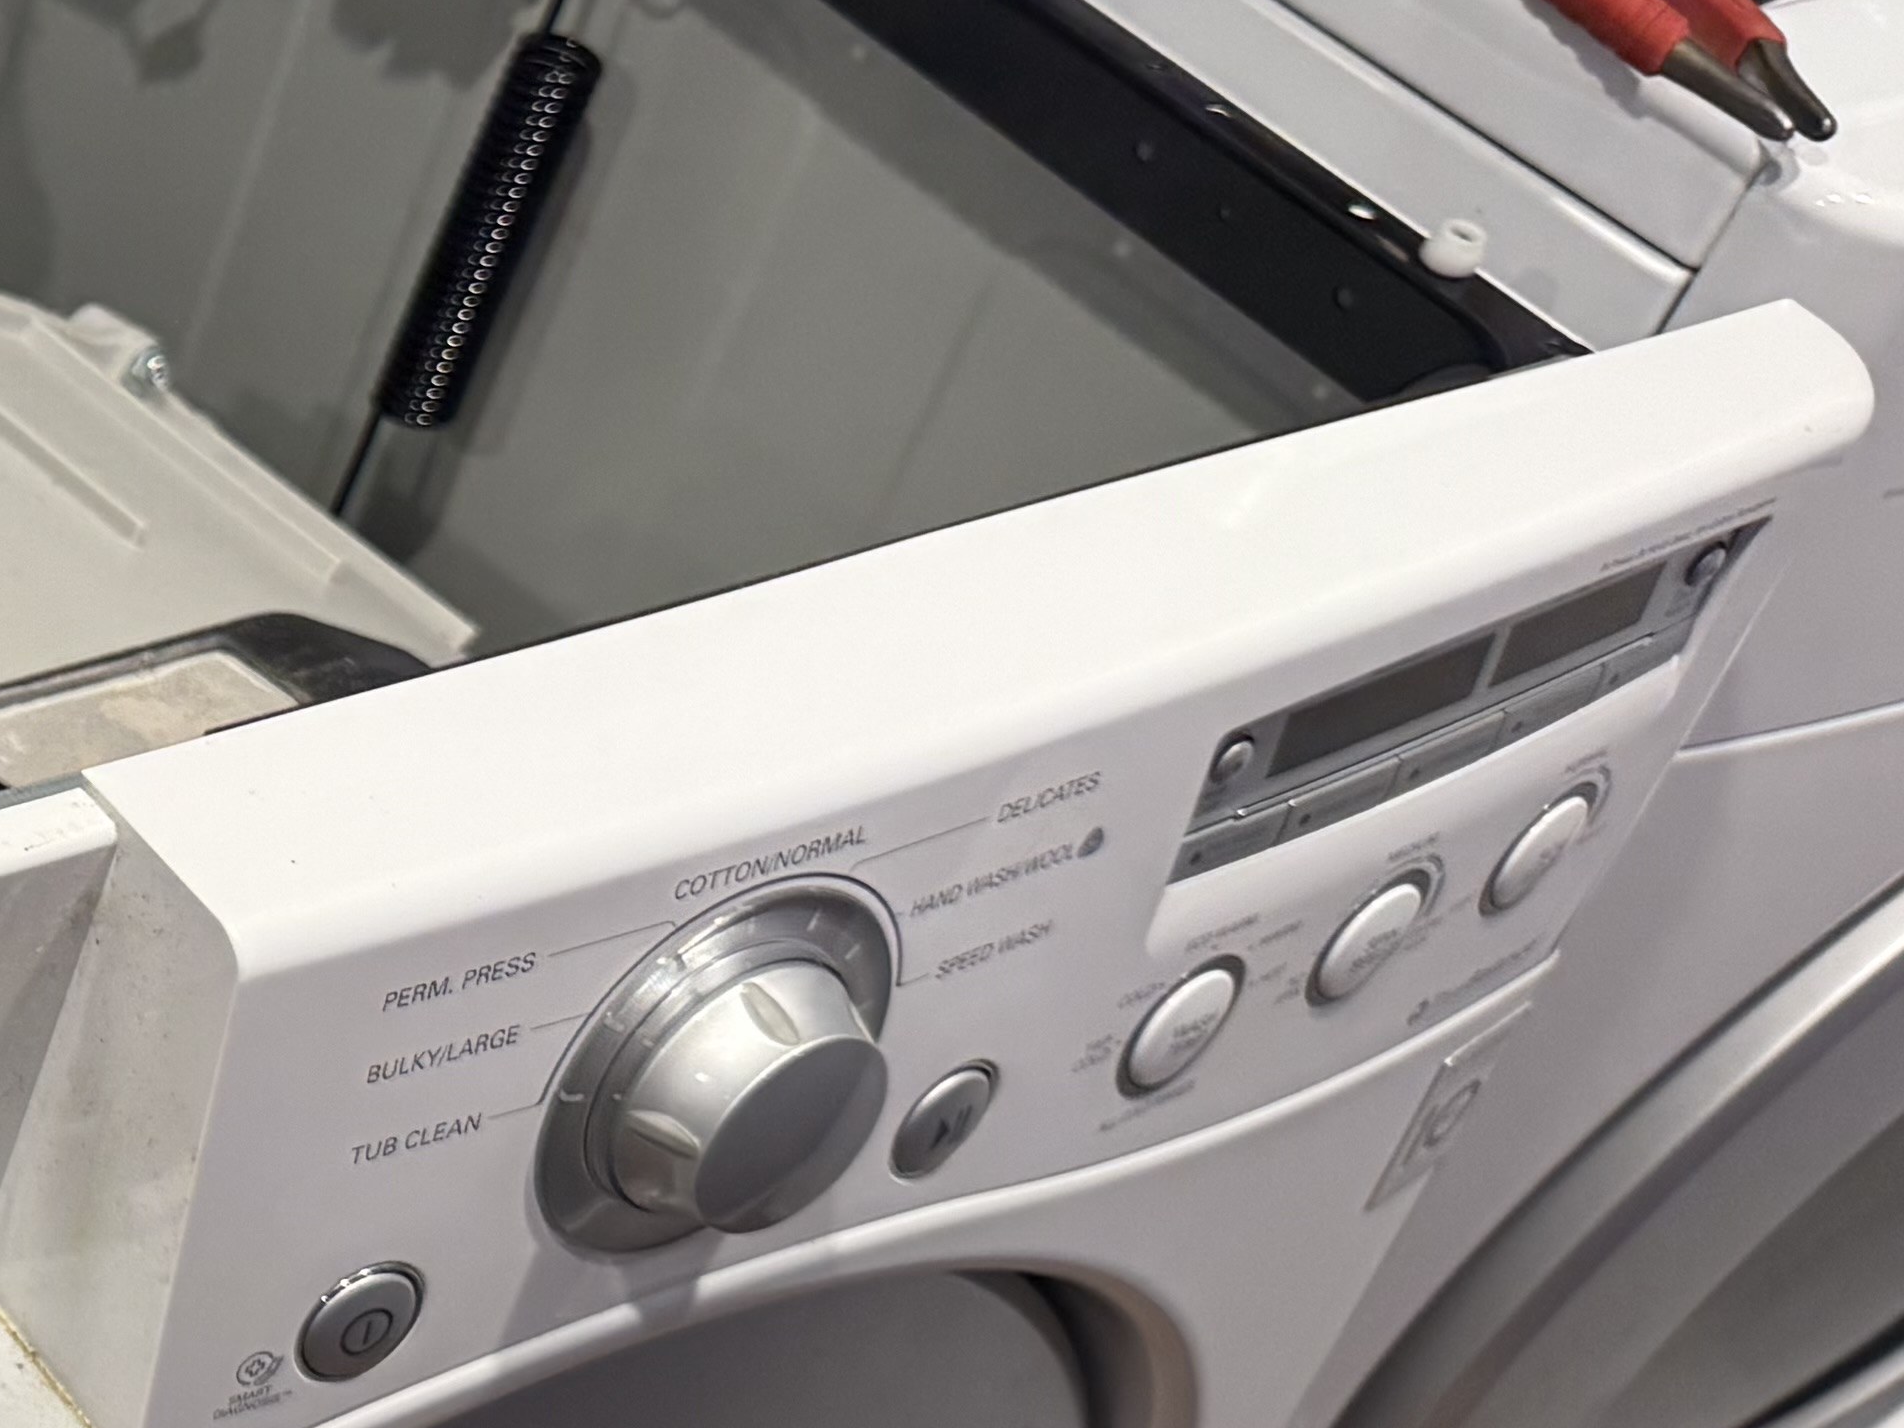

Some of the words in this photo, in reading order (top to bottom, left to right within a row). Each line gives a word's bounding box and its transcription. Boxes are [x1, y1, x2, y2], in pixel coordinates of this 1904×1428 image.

[997, 772, 1102, 824] DELICATES
[673, 824, 869, 901] COTTON/NORMAL
[909, 883, 963, 917] HAND
[935, 942, 994, 980] SPEED
[996, 919, 1054, 954] WASH
[382, 976, 454, 1013] PERM.
[461, 951, 537, 990] PRESS
[366, 1024, 521, 1084] BULKY/LARGE
[351, 1136, 398, 1165] TUB
[405, 1112, 482, 1150] CLEAN
